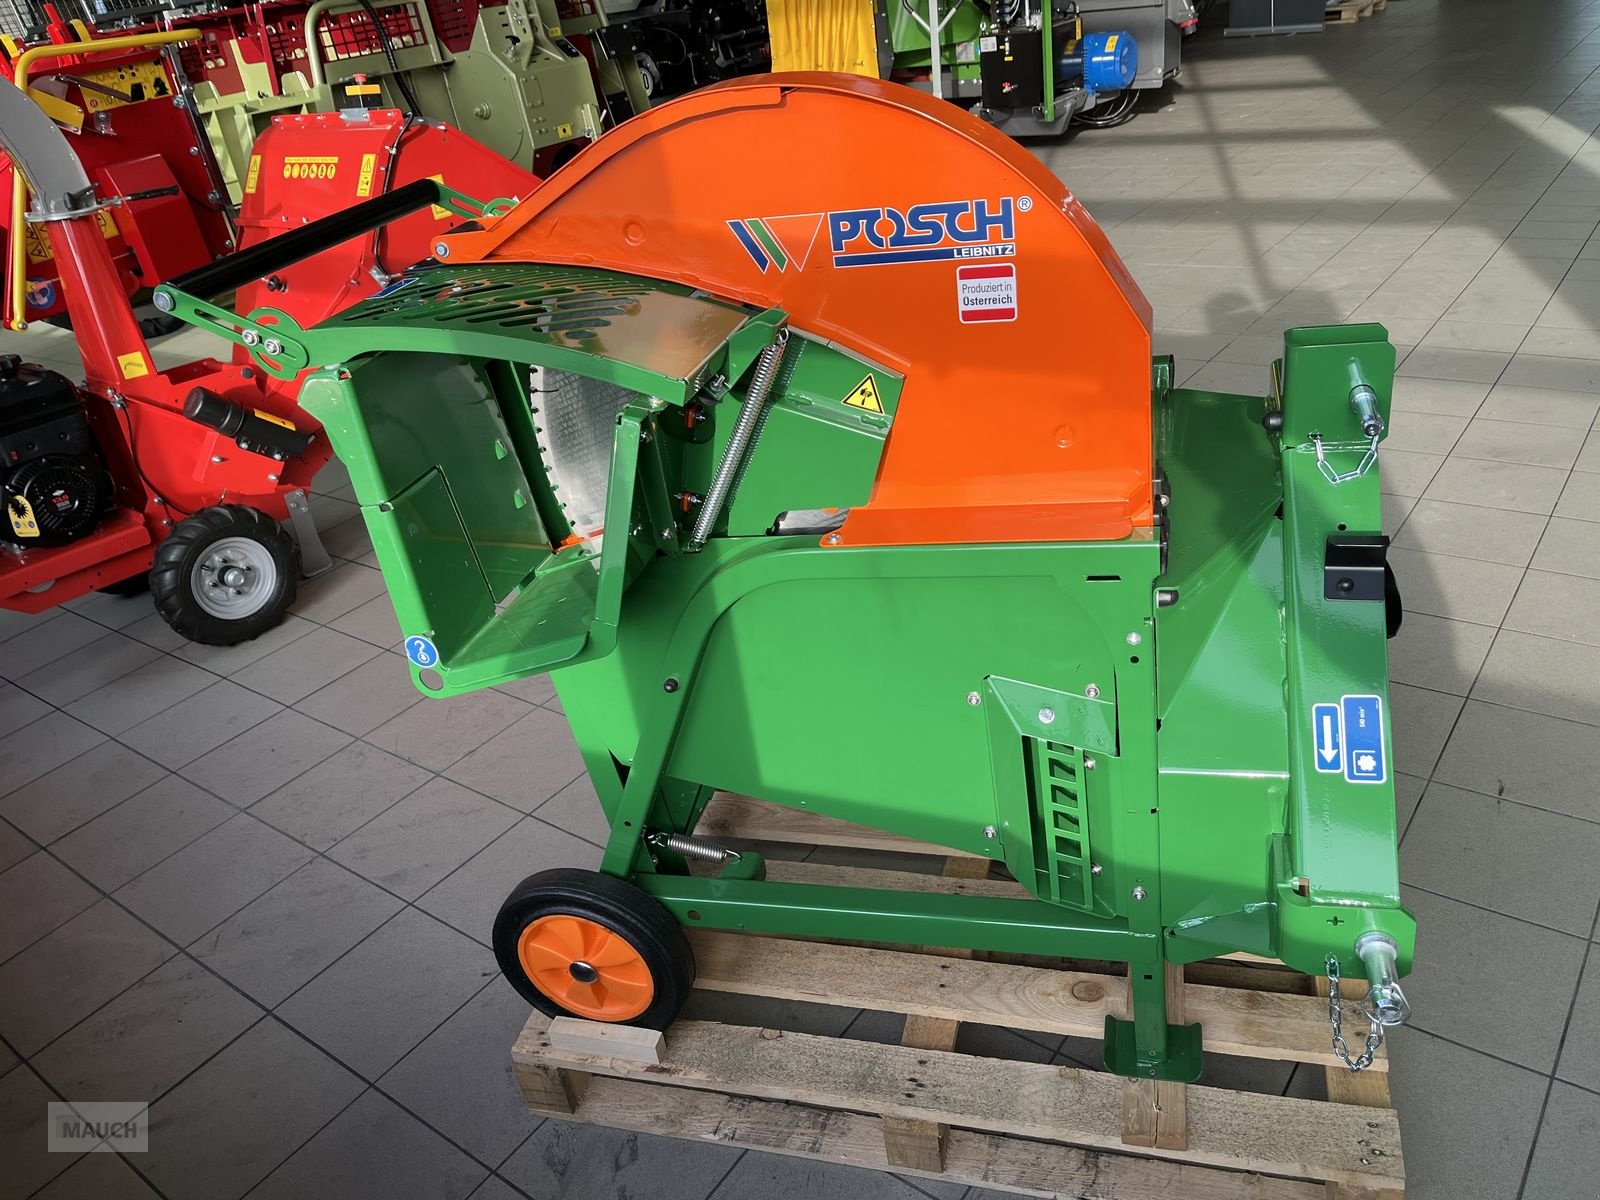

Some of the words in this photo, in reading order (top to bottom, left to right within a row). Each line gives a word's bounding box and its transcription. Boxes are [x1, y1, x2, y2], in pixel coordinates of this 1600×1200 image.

[828, 197, 1015, 252] POSCH
[953, 244, 1014, 258] LEIBNITZ
[962, 282, 1003, 294] Produziert
[1004, 281, 1012, 292] in
